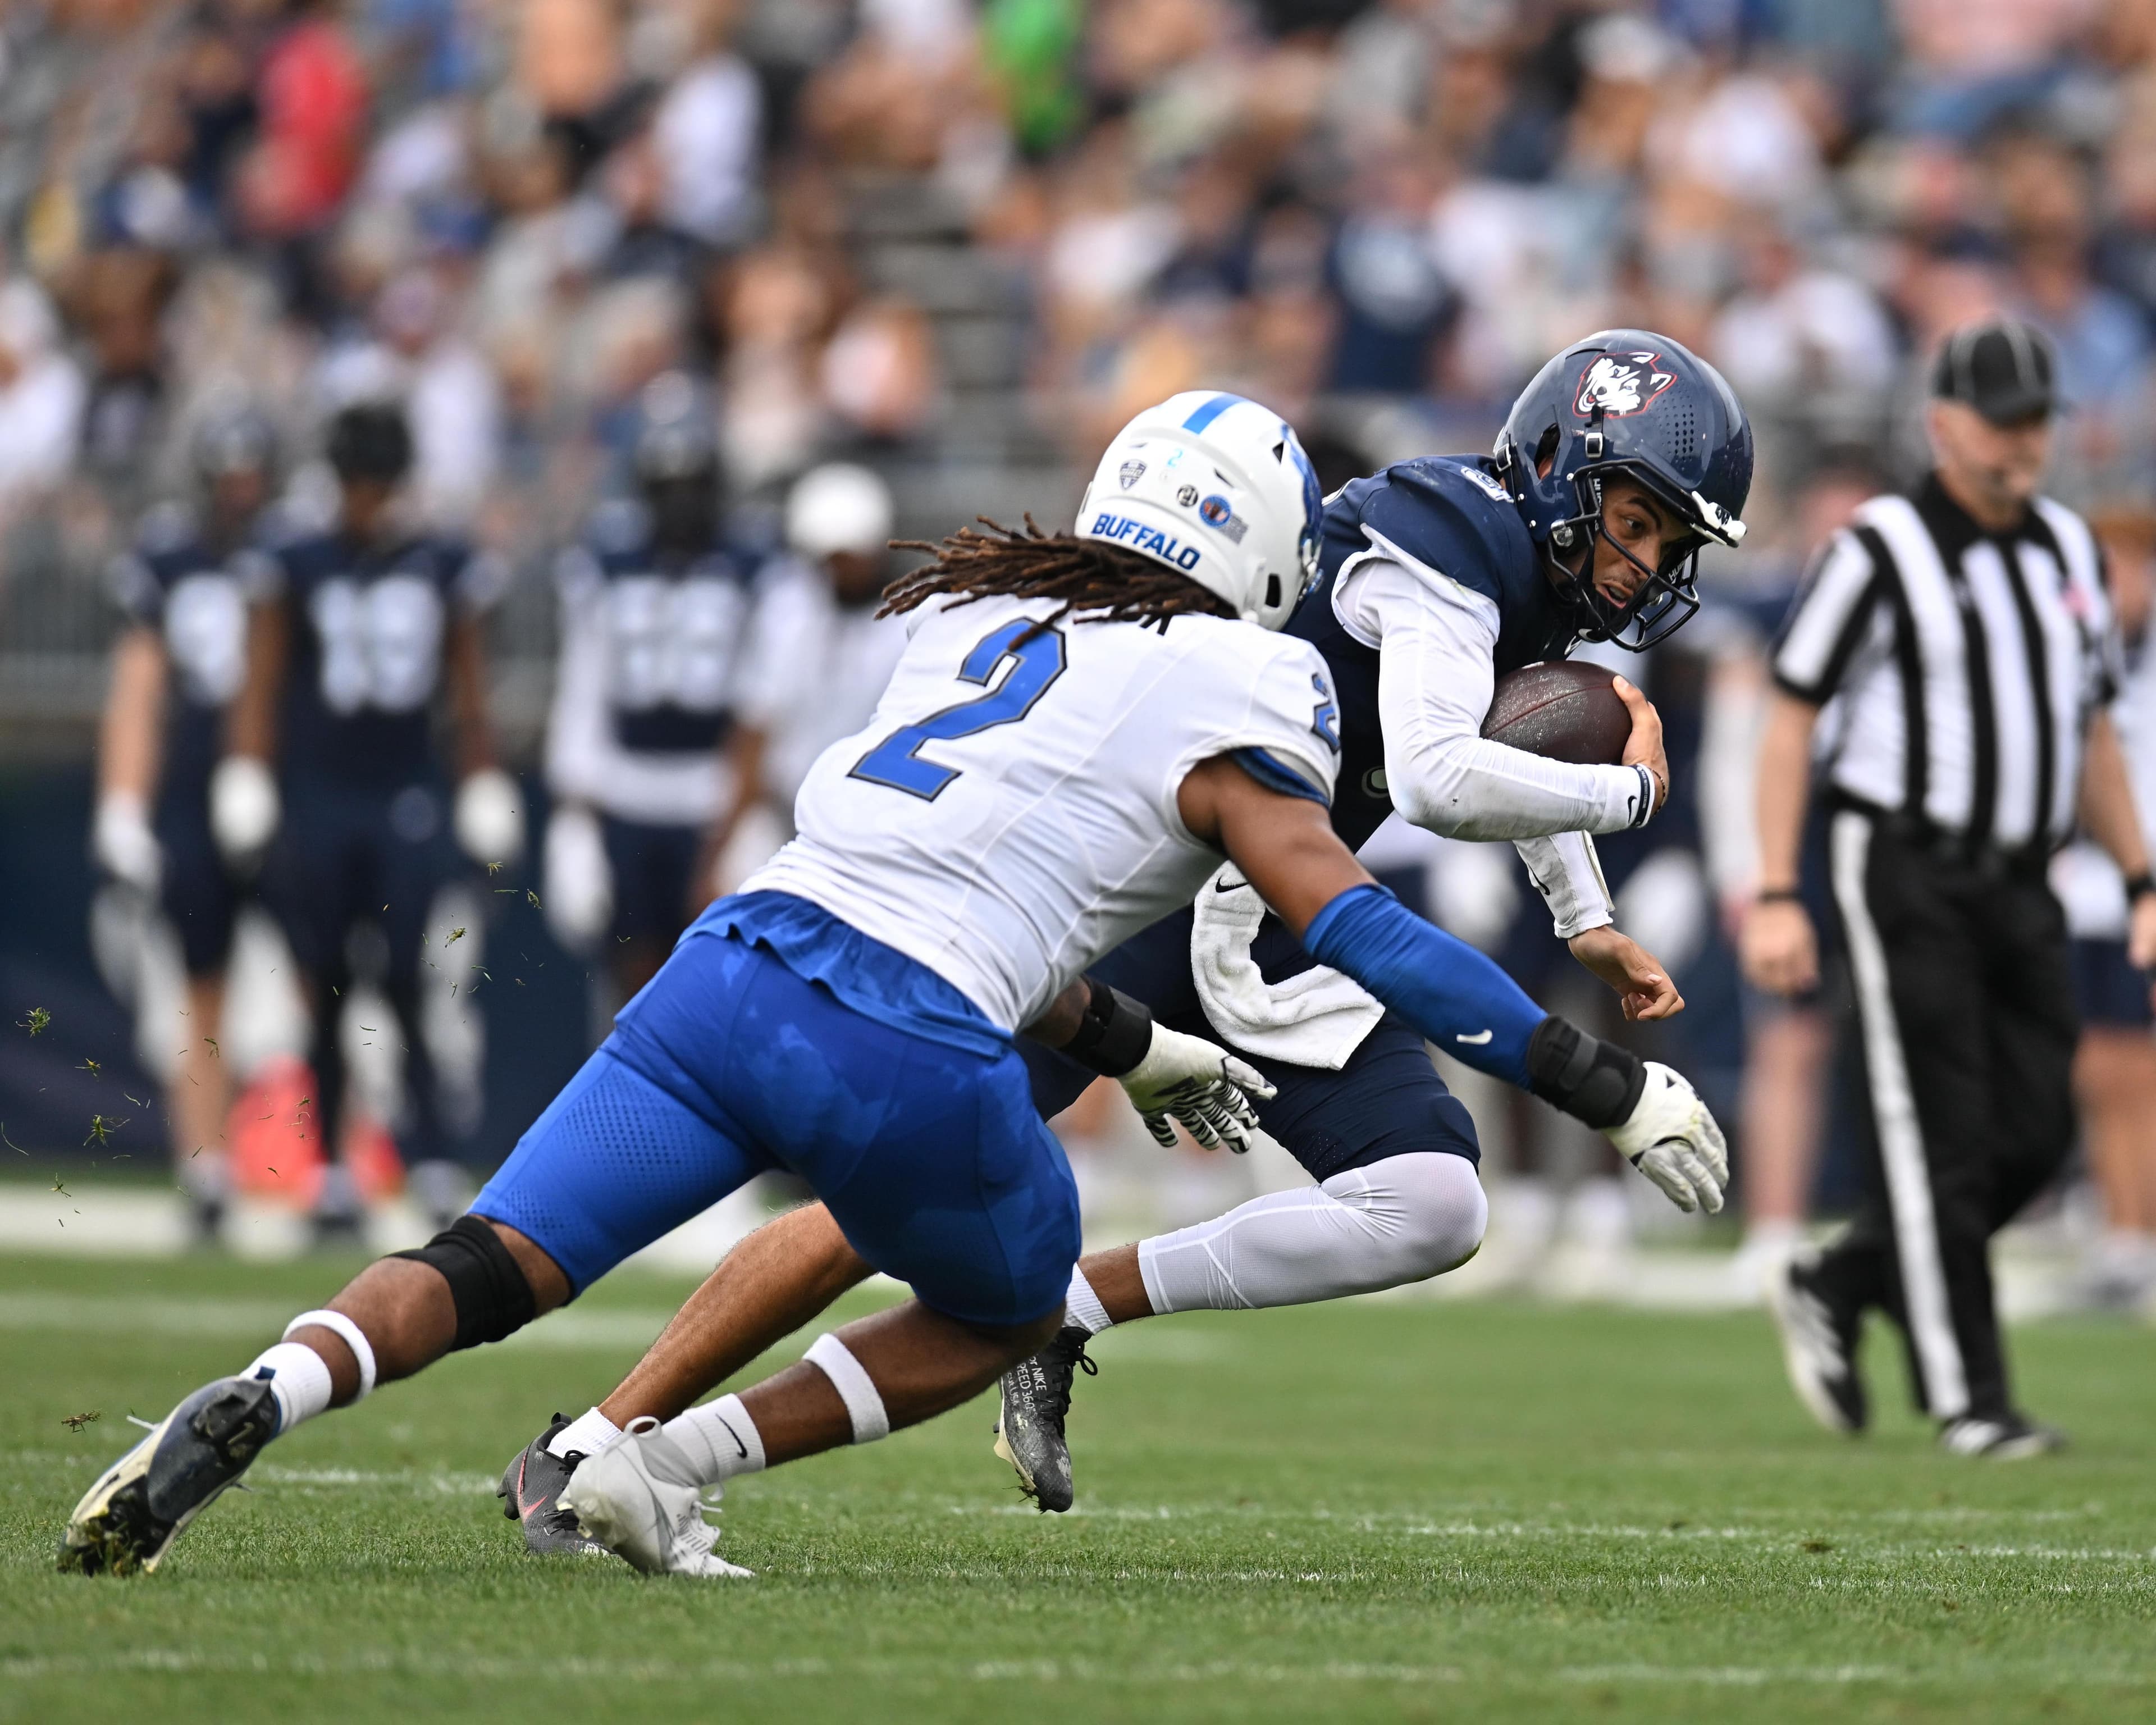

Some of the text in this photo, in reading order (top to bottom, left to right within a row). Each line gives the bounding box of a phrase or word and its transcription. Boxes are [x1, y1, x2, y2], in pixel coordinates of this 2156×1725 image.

[1091, 513, 1200, 570] BUFFALO
[846, 615, 1067, 803] 2
[1310, 672, 1341, 756] 2
[1031, 1367, 1047, 1391] NIKE
